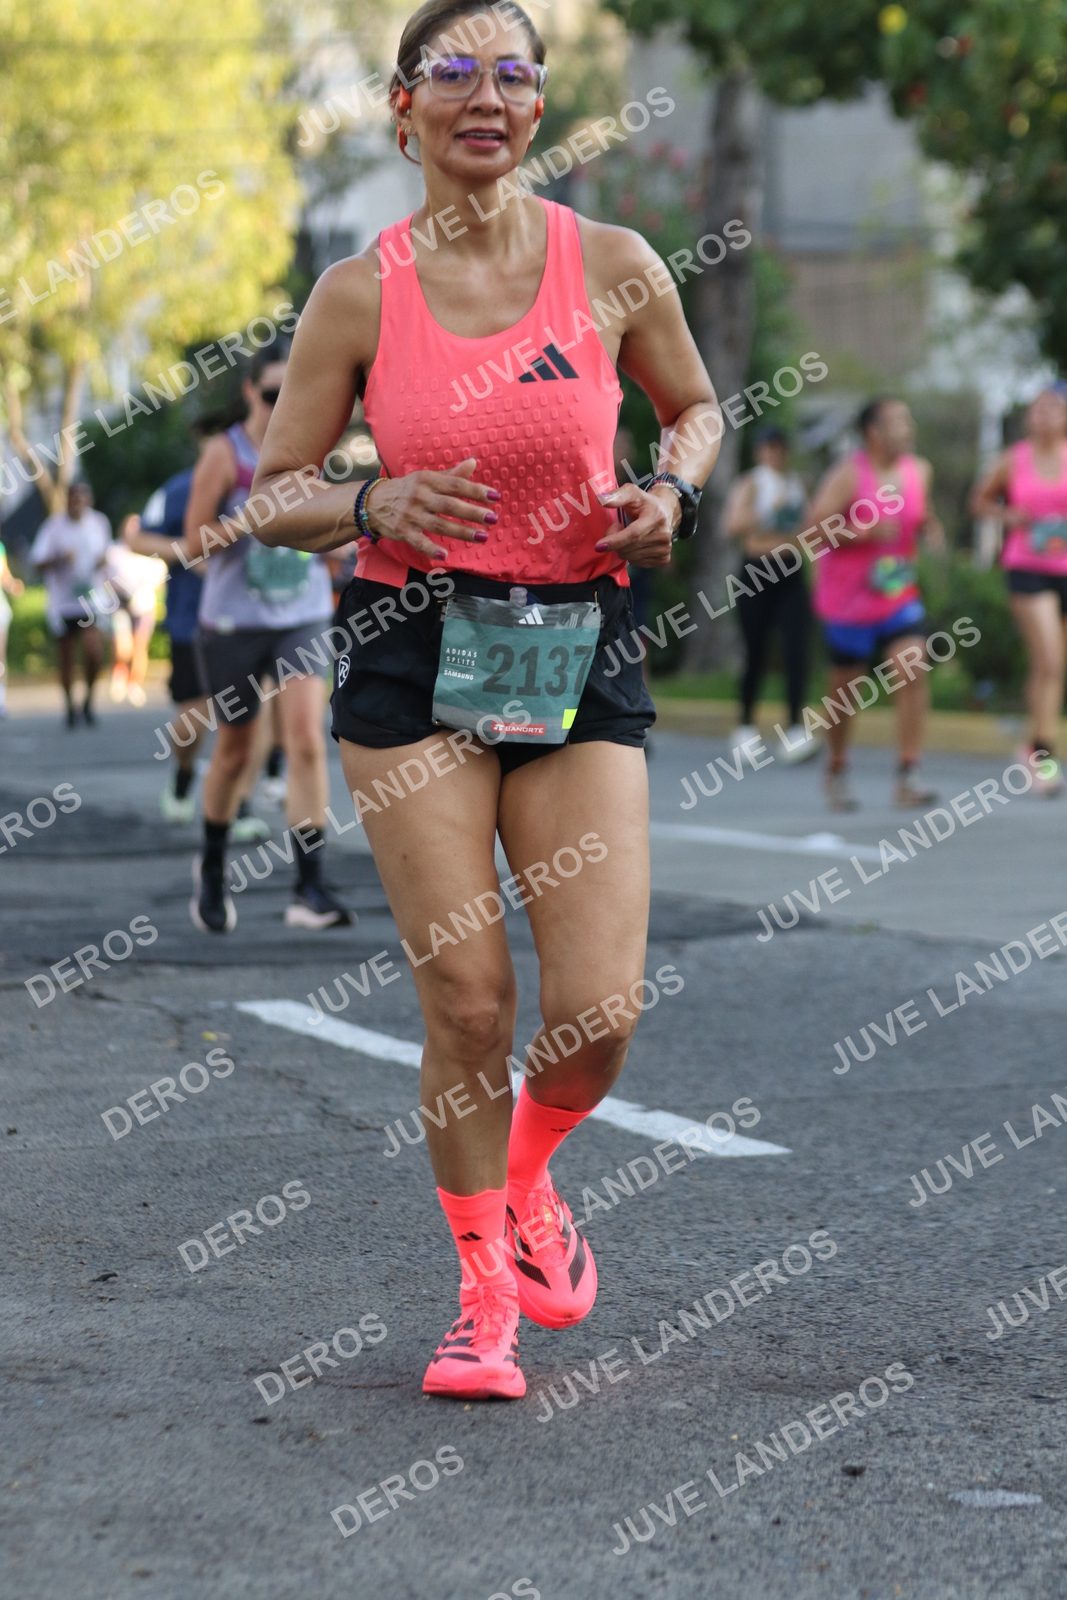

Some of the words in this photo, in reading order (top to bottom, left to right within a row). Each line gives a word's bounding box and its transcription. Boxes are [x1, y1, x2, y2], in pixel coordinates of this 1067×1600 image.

[446, 647, 477, 658] ADIDAS
[446, 656, 475, 667] SPLITS
[444, 669, 474, 680] SAMSUNG
[482, 643, 593, 697] 2137
